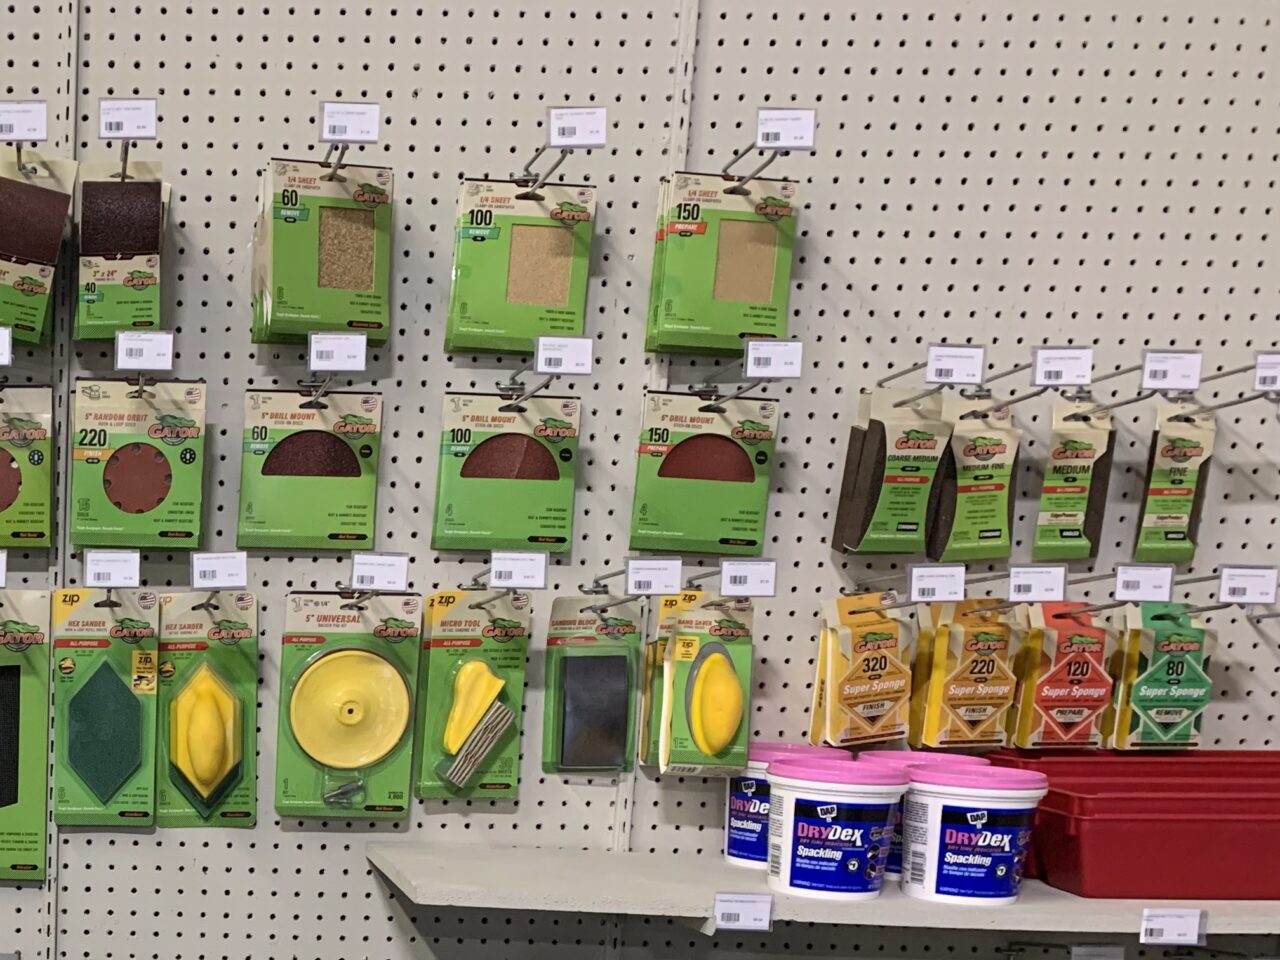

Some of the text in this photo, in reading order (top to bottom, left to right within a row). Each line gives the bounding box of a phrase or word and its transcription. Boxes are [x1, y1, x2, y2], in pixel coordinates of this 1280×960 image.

[281, 190, 298, 207] 60
[550, 207, 590, 223] GATOR
[676, 203, 700, 221] 150
[755, 201, 793, 217] GATOR
[468, 209, 492, 227] 100
[85, 282, 96, 294] 40
[122, 276, 158, 288] GATOR
[79, 428, 107, 447] 220
[251, 426, 268, 442] 60
[450, 428, 471, 444] 100
[648, 428, 669, 443] 150
[1052, 463, 1091, 476] MEDIUM
[1169, 466, 1188, 478] FINE
[440, 619, 480, 628] MICRO TOOL
[853, 637, 898, 653] GATOR
[862, 657, 887, 674] 320
[969, 660, 995, 675] 220
[1066, 661, 1089, 677] 120
[1166, 661, 1184, 677] 80
[844, 678, 906, 695] Super Sponge
[948, 684, 1010, 698] Super Sponge
[1041, 686, 1106, 700] Super Sponge
[1139, 686, 1205, 700] Super Sponge
[820, 806, 836, 817] DAP
[970, 812, 987, 823] DAP
[797, 845, 842, 860] Spackling
[944, 852, 992, 866] Spackling
